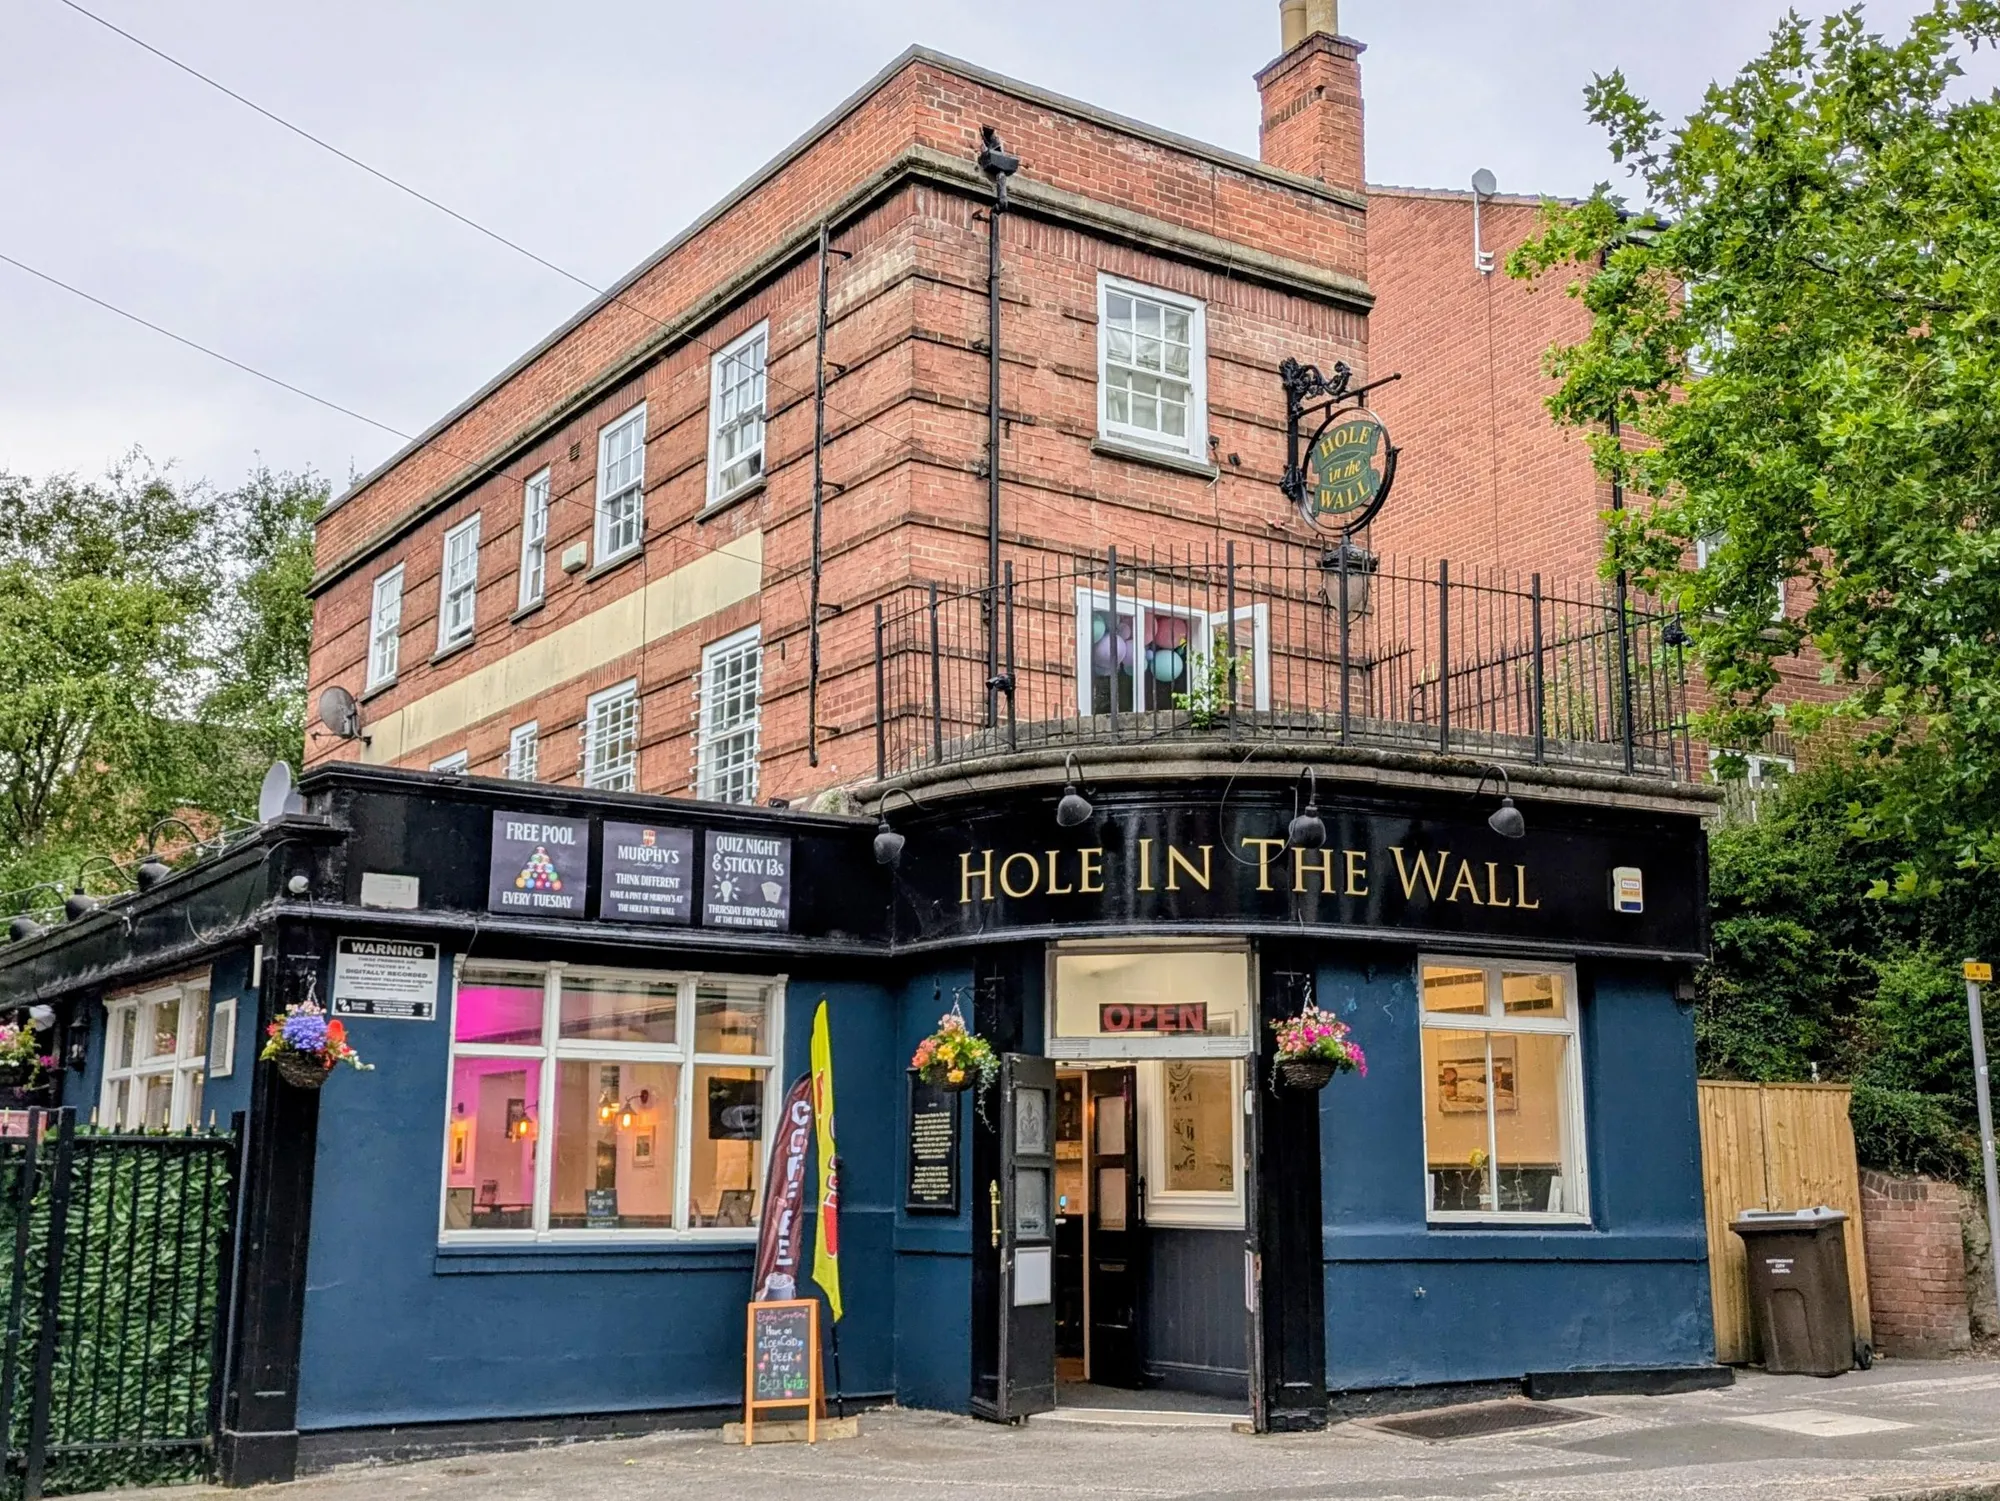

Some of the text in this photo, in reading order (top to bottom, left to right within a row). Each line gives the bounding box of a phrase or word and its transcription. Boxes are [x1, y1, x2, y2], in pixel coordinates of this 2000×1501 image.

[1320, 426, 1372, 459] HOLE
[1328, 459, 1360, 483] in the
[1321, 480, 1370, 510] WALL
[506, 821, 576, 845] FREE POOL
[617, 845, 680, 864] MURPHY'S
[716, 835, 782, 856] QUIZ NIGHT
[712, 853, 722, 871] &
[723, 856, 764, 875] STICKY
[959, 848, 1105, 904] HOLE
[1241, 837, 1369, 897] THE
[1388, 846, 1539, 909] WALL
[615, 872, 680, 889] THINK DIFFERENT
[502, 891, 573, 909] EVERY TUESDAY
[610, 890, 624, 899] HAVE
[624, 891, 629, 899] A
[629, 891, 641, 900] PINT
[642, 892, 649, 901] OF
[675, 895, 684, 903] AT
[617, 903, 675, 916] THE HOLE IN THE WALL
[707, 903, 741, 916] THURSDAY
[742, 905, 760, 917] FROM
[714, 915, 778, 928] AT THE HOLE IN THE WALL
[351, 942, 424, 957] WARNING
[345, 968, 385, 976] DIGITALLY
[1103, 1004, 1204, 1031] OPEN
